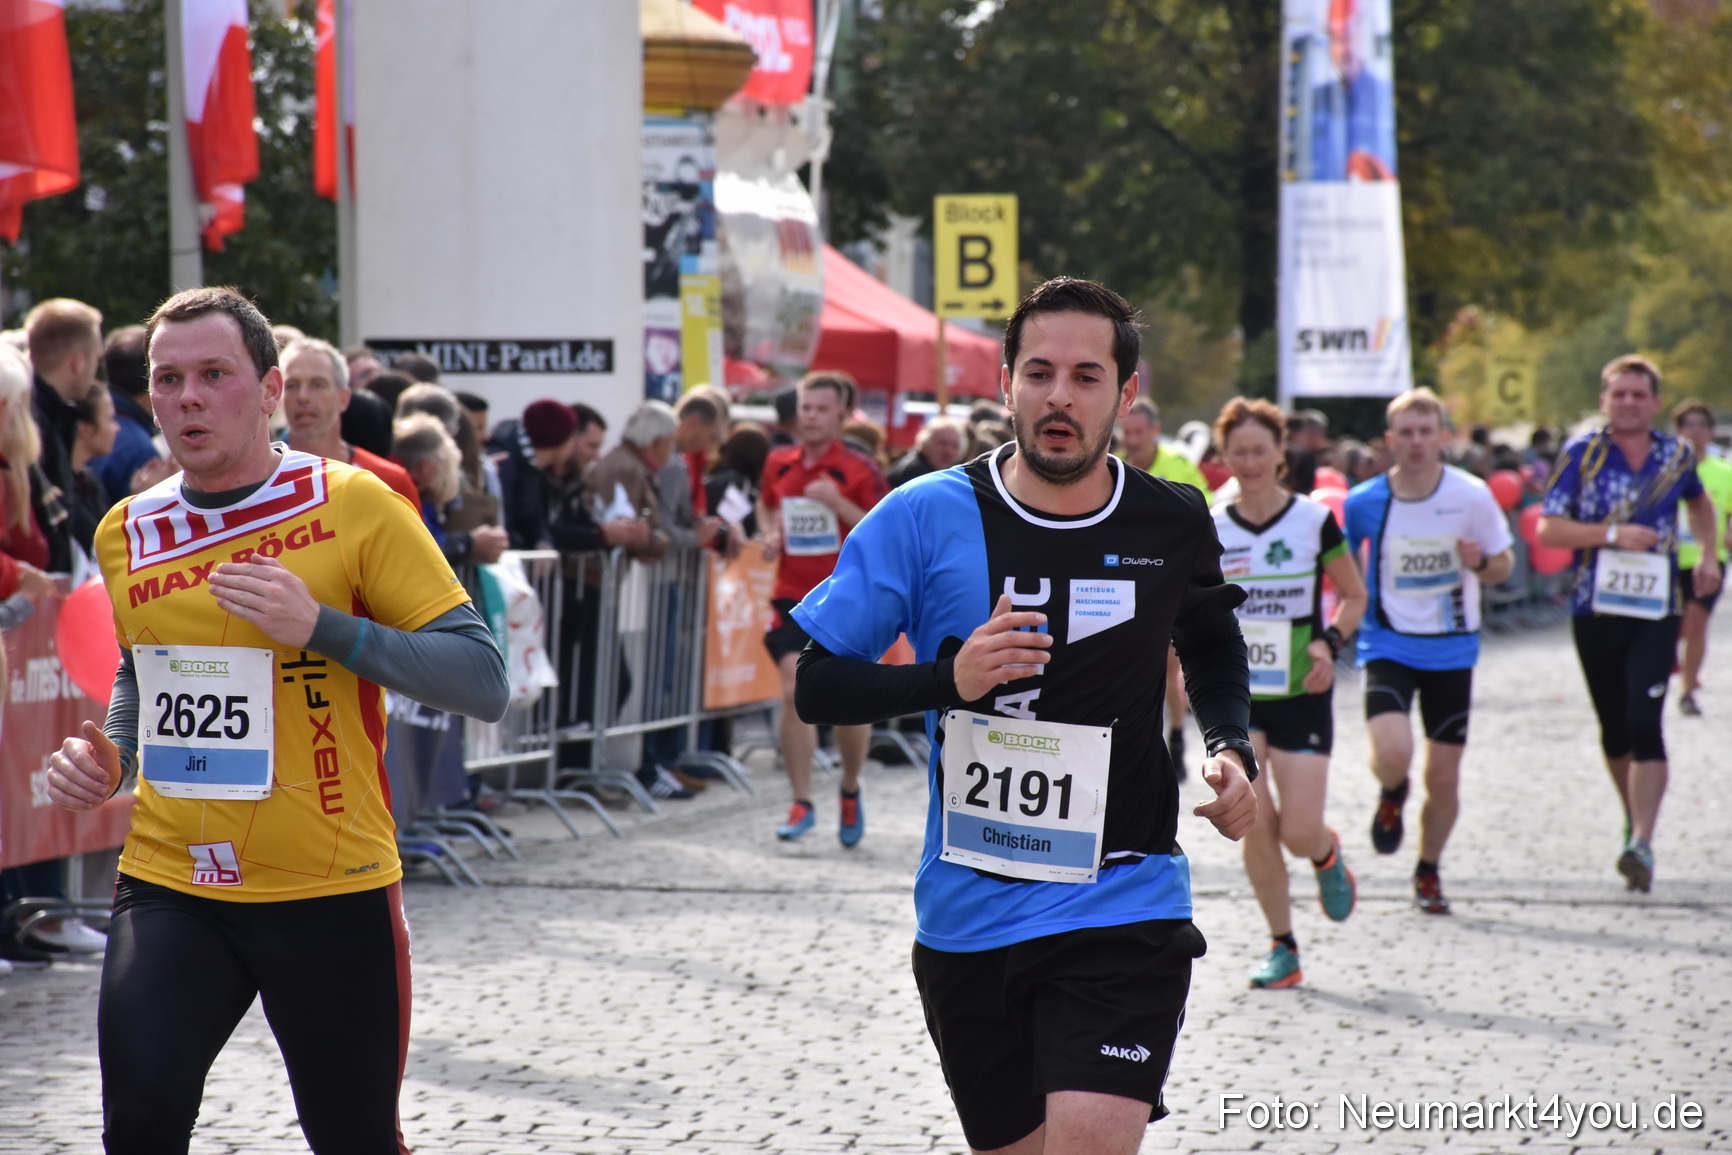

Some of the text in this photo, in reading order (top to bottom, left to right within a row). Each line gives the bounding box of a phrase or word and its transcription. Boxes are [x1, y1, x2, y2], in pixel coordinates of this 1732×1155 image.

[958, 234, 995, 289] B
[1497, 371, 1522, 405] C
[128, 560, 215, 609] MAX
[1607, 569, 1658, 593] 2137
[1249, 587, 1304, 599] fteam
[180, 660, 229, 673] BOCK
[155, 692, 250, 740] 2625
[146, 730, 151, 738] D
[1004, 732, 1061, 752] BOCK
[185, 755, 207, 772] Jiri
[951, 796, 957, 806] C
[965, 761, 1073, 820] 2191
[982, 826, 1052, 853] Christian
[1100, 1044, 1141, 1062] JAKO
